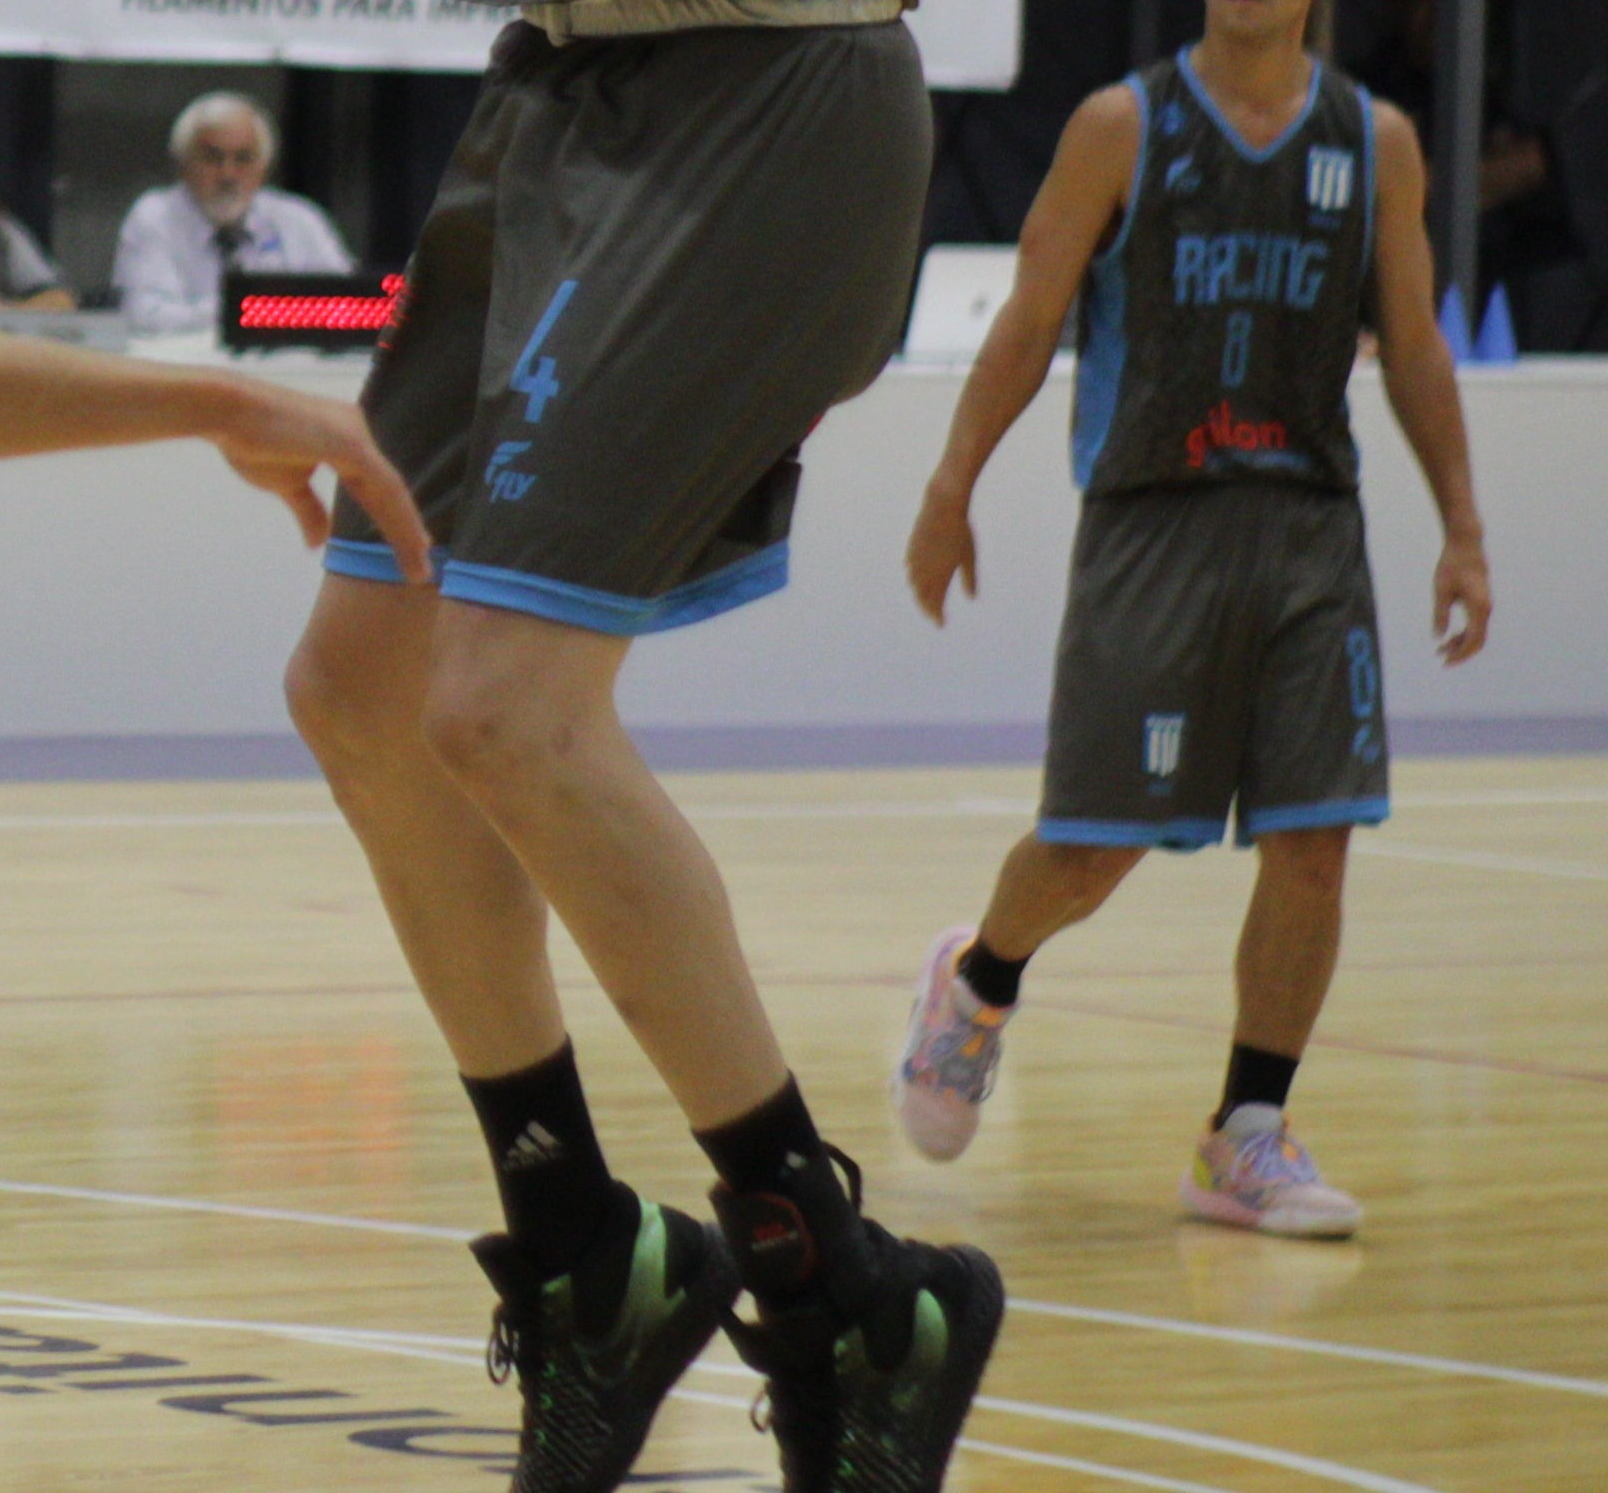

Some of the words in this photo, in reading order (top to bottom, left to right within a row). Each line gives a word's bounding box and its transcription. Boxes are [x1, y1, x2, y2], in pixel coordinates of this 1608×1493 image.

[1174, 232, 1329, 311] RACING
[509, 279, 579, 423] 4
[1346, 626, 1378, 719] 8
